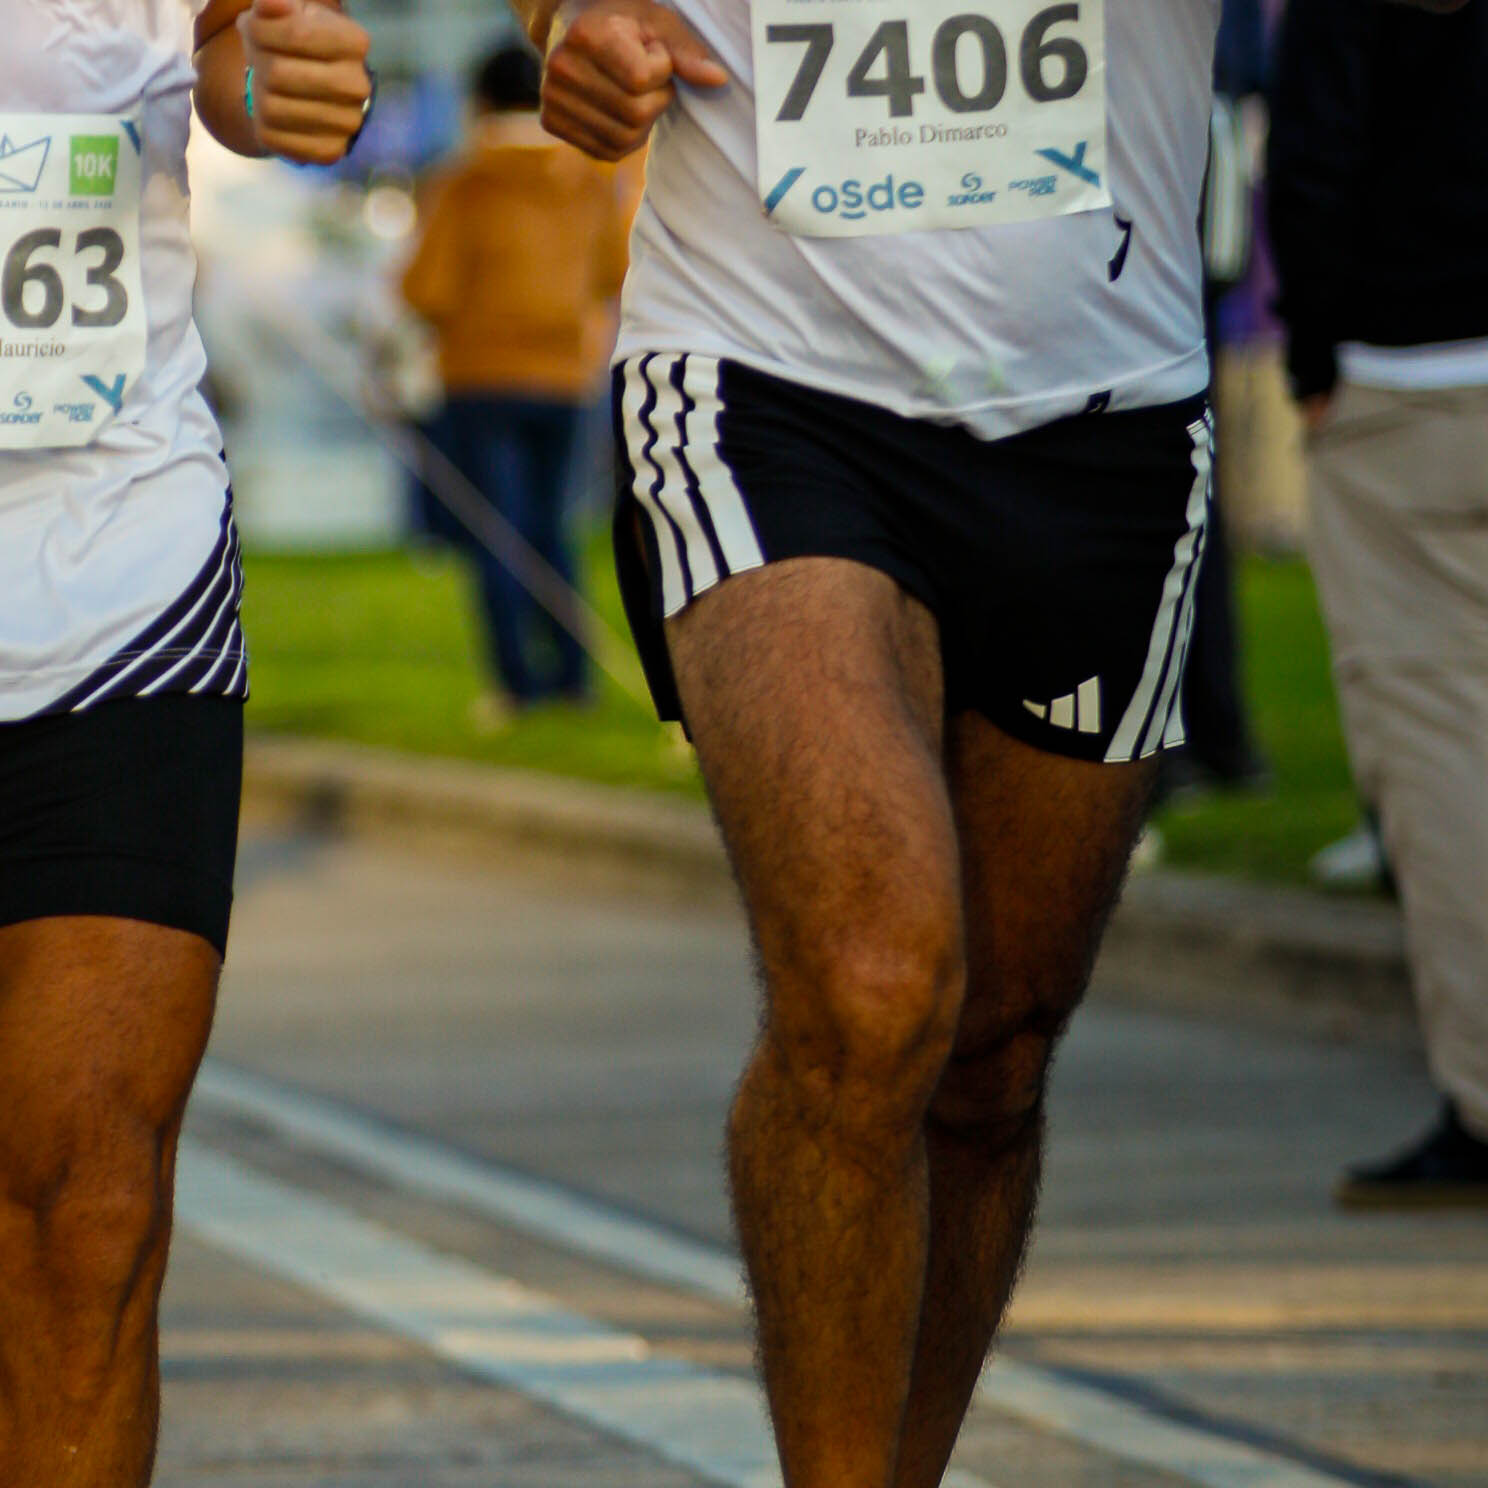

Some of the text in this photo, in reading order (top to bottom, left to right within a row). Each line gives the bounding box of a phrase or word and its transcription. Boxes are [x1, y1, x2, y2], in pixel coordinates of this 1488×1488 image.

[766, 3, 1088, 122] 7406
[855, 121, 1008, 147] Pablo Dimarco
[74, 151, 113, 177] 10K
[812, 174, 924, 216] osde
